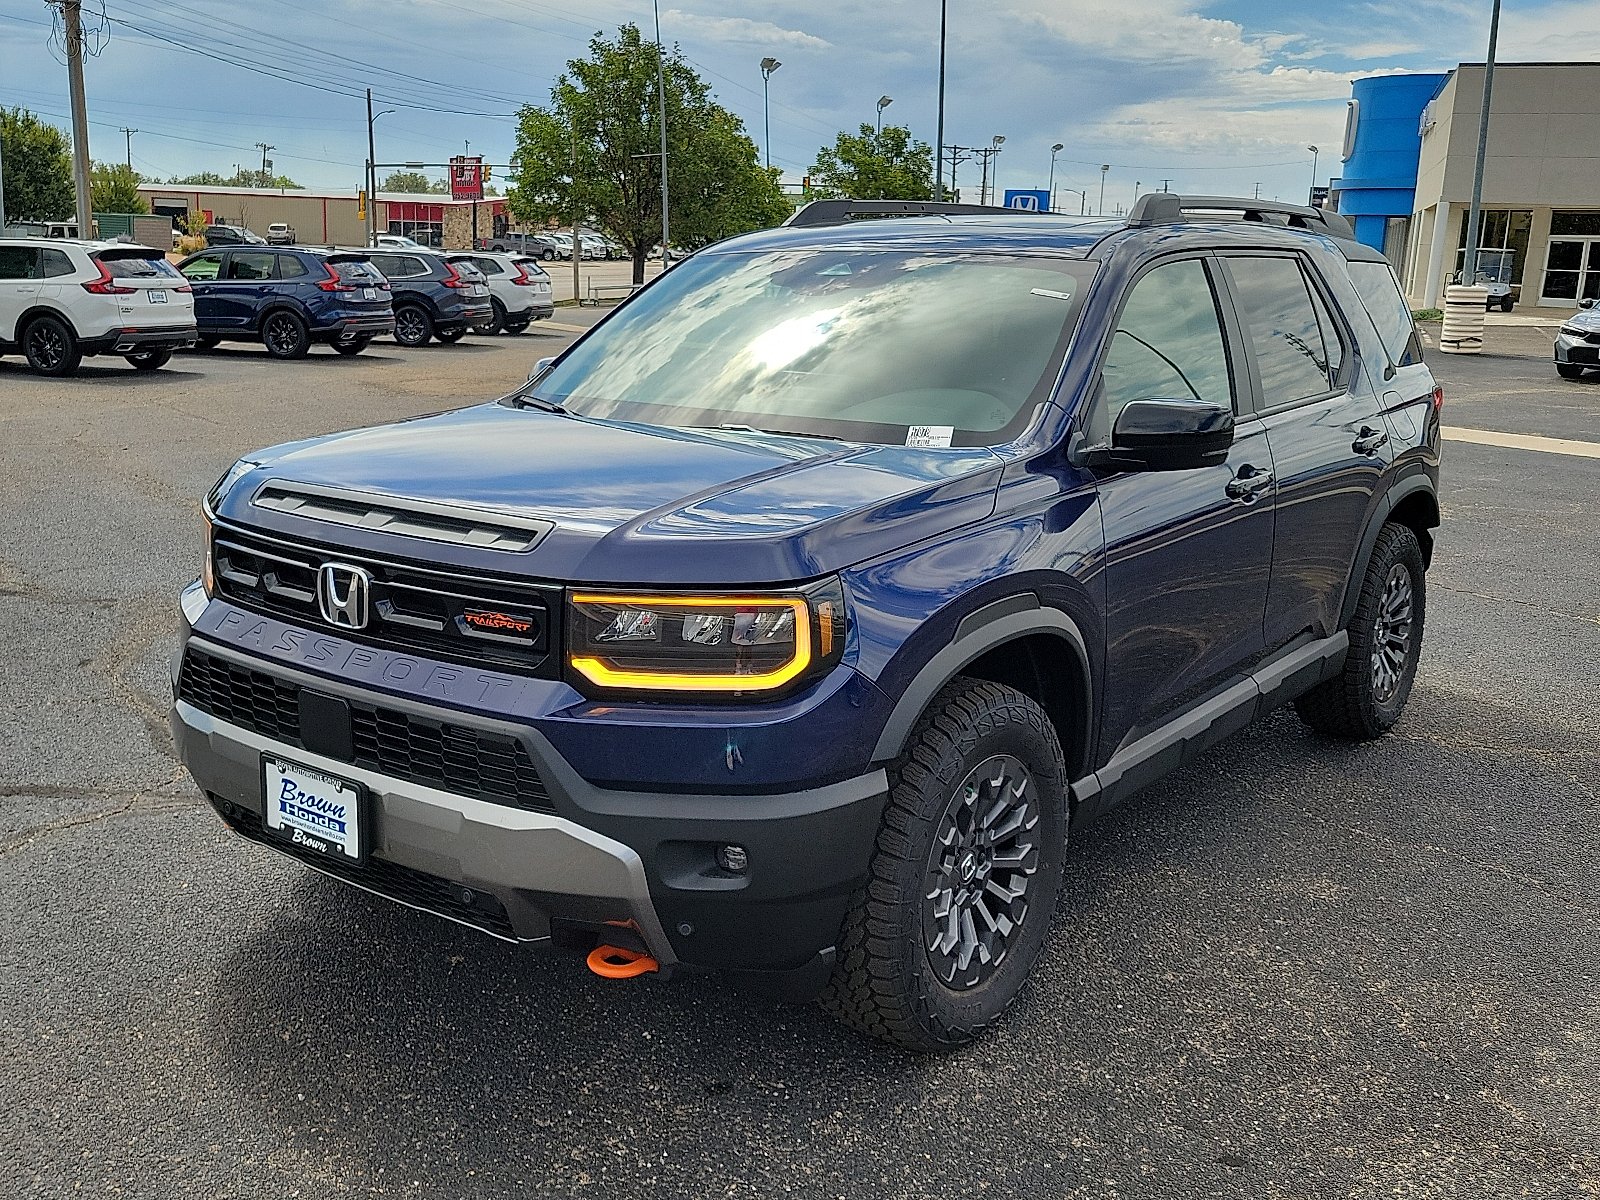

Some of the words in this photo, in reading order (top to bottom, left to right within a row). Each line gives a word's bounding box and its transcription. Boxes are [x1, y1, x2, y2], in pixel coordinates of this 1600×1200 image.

[465, 614, 531, 631] TRAILSPORT
[215, 610, 512, 702] PASSPORT
[280, 778, 346, 818] Brown
[286, 803, 340, 831] Honda
[292, 829, 328, 852] Brown
